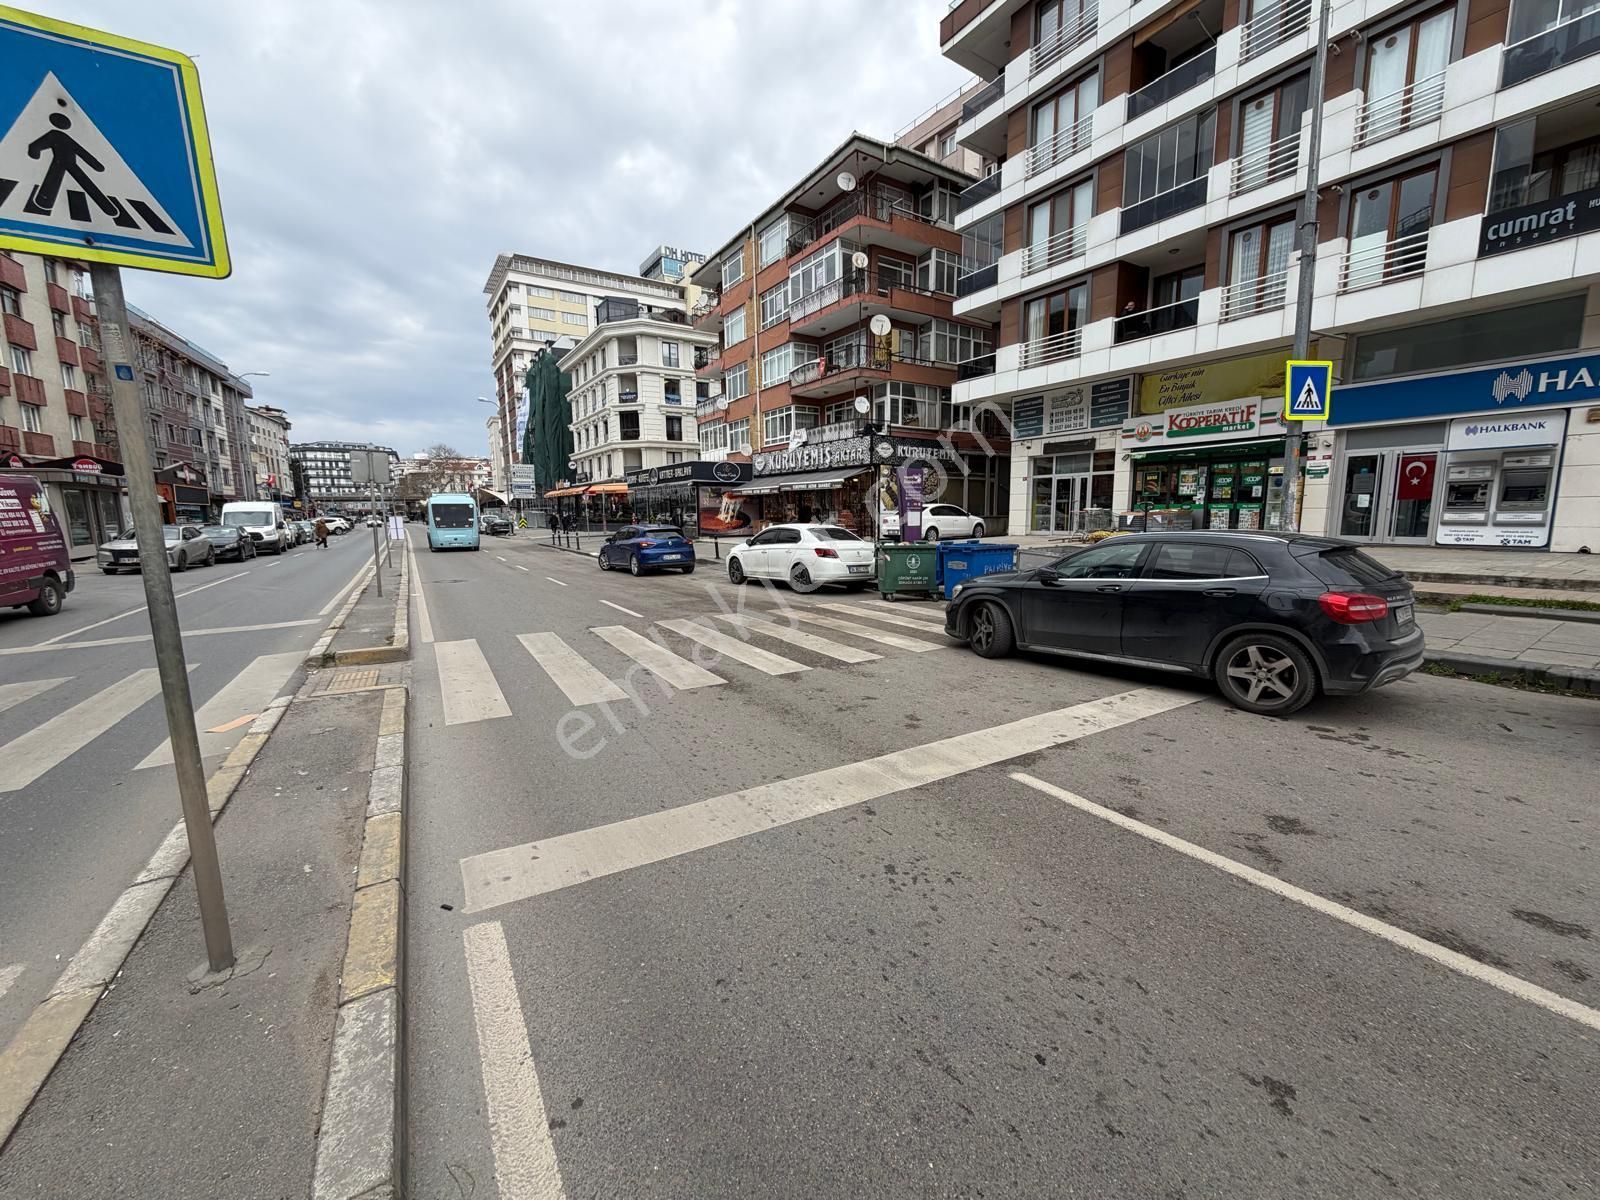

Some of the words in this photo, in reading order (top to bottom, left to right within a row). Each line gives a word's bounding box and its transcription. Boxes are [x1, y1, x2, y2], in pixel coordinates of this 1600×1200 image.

[1487, 201, 1577, 241] cumrat
[664, 246, 677, 259] DH
[1538, 367, 1600, 392] HA
[1206, 407, 1224, 415] TARIM
[1168, 404, 1257, 432] KOOPERATİF
[1222, 423, 1250, 432] market
[1480, 421, 1547, 434] HALKBANK
[834, 448, 863, 462] AKTAR
